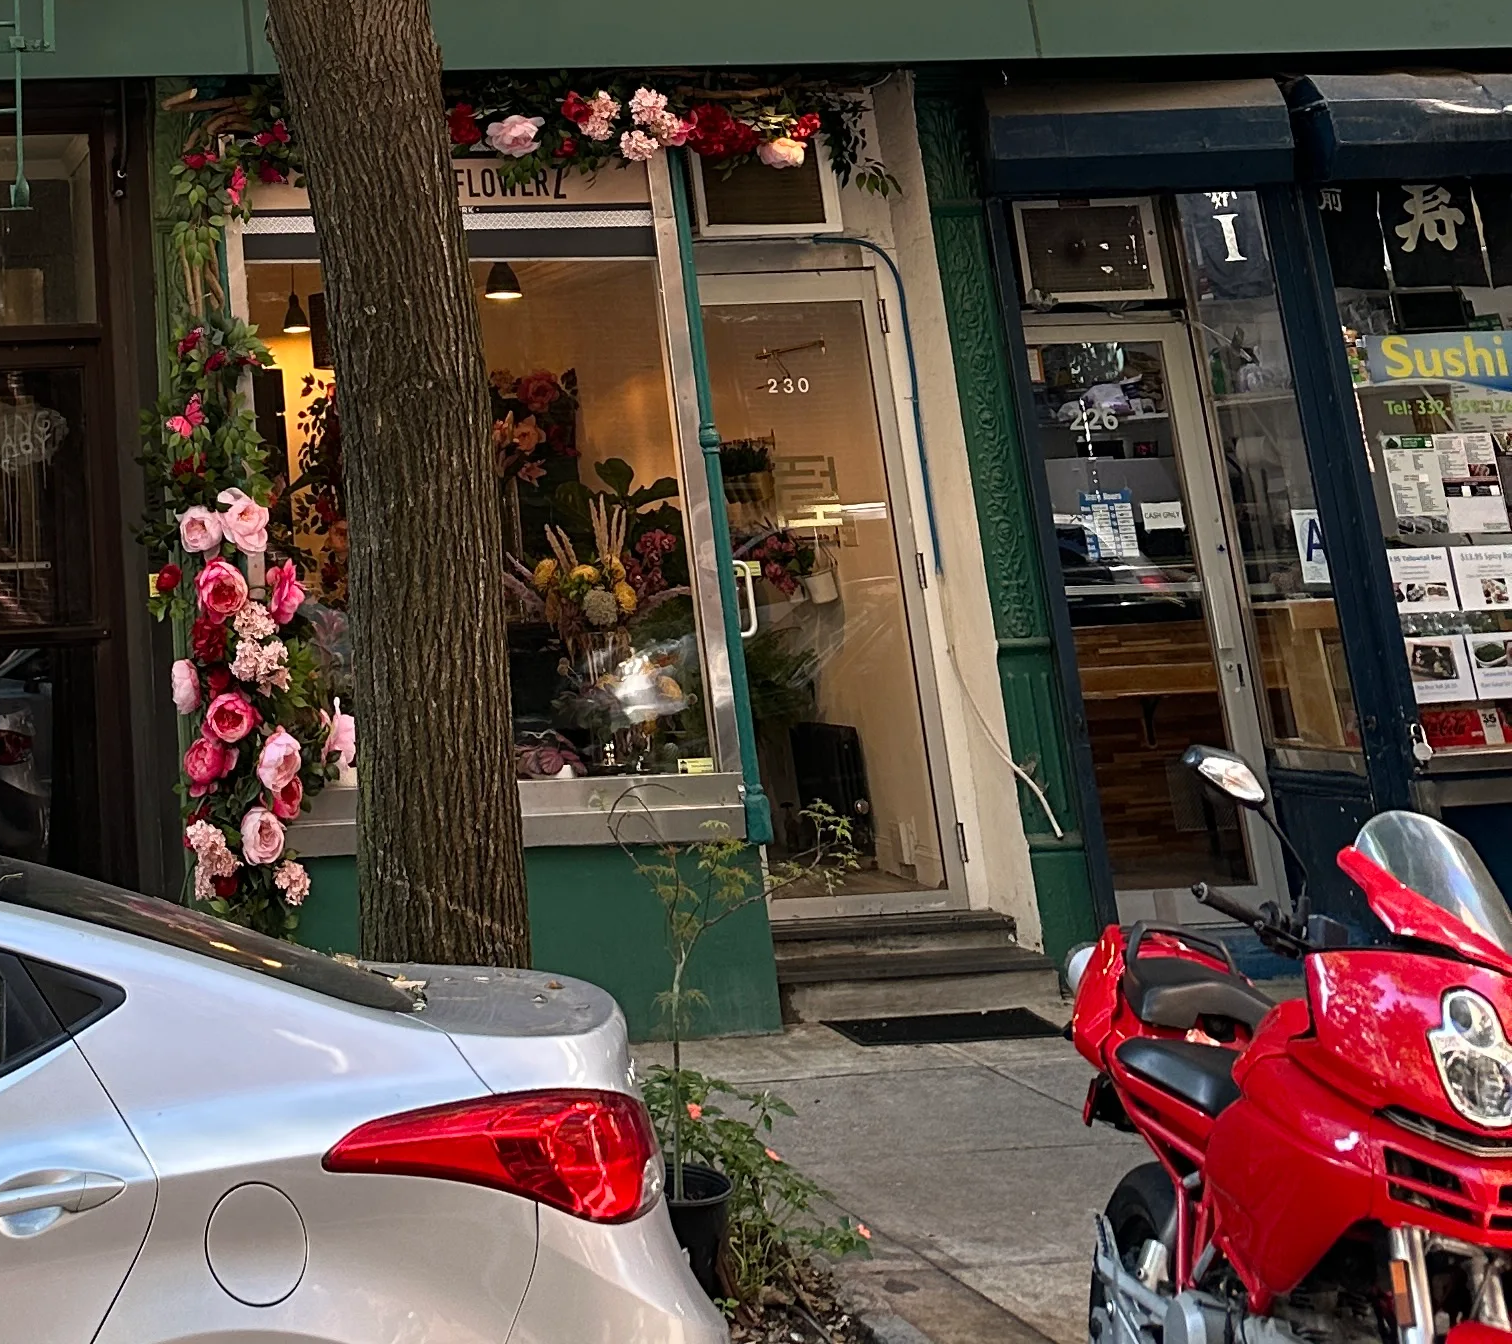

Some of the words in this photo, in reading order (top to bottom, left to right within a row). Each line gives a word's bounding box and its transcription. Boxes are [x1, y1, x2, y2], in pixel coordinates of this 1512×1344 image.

[1381, 335, 1509, 378] Sushi
[767, 377, 810, 394] 230
[1070, 406, 1119, 431] 226
[1383, 400, 1412, 415] Tel:
[1306, 519, 1326, 561] A
